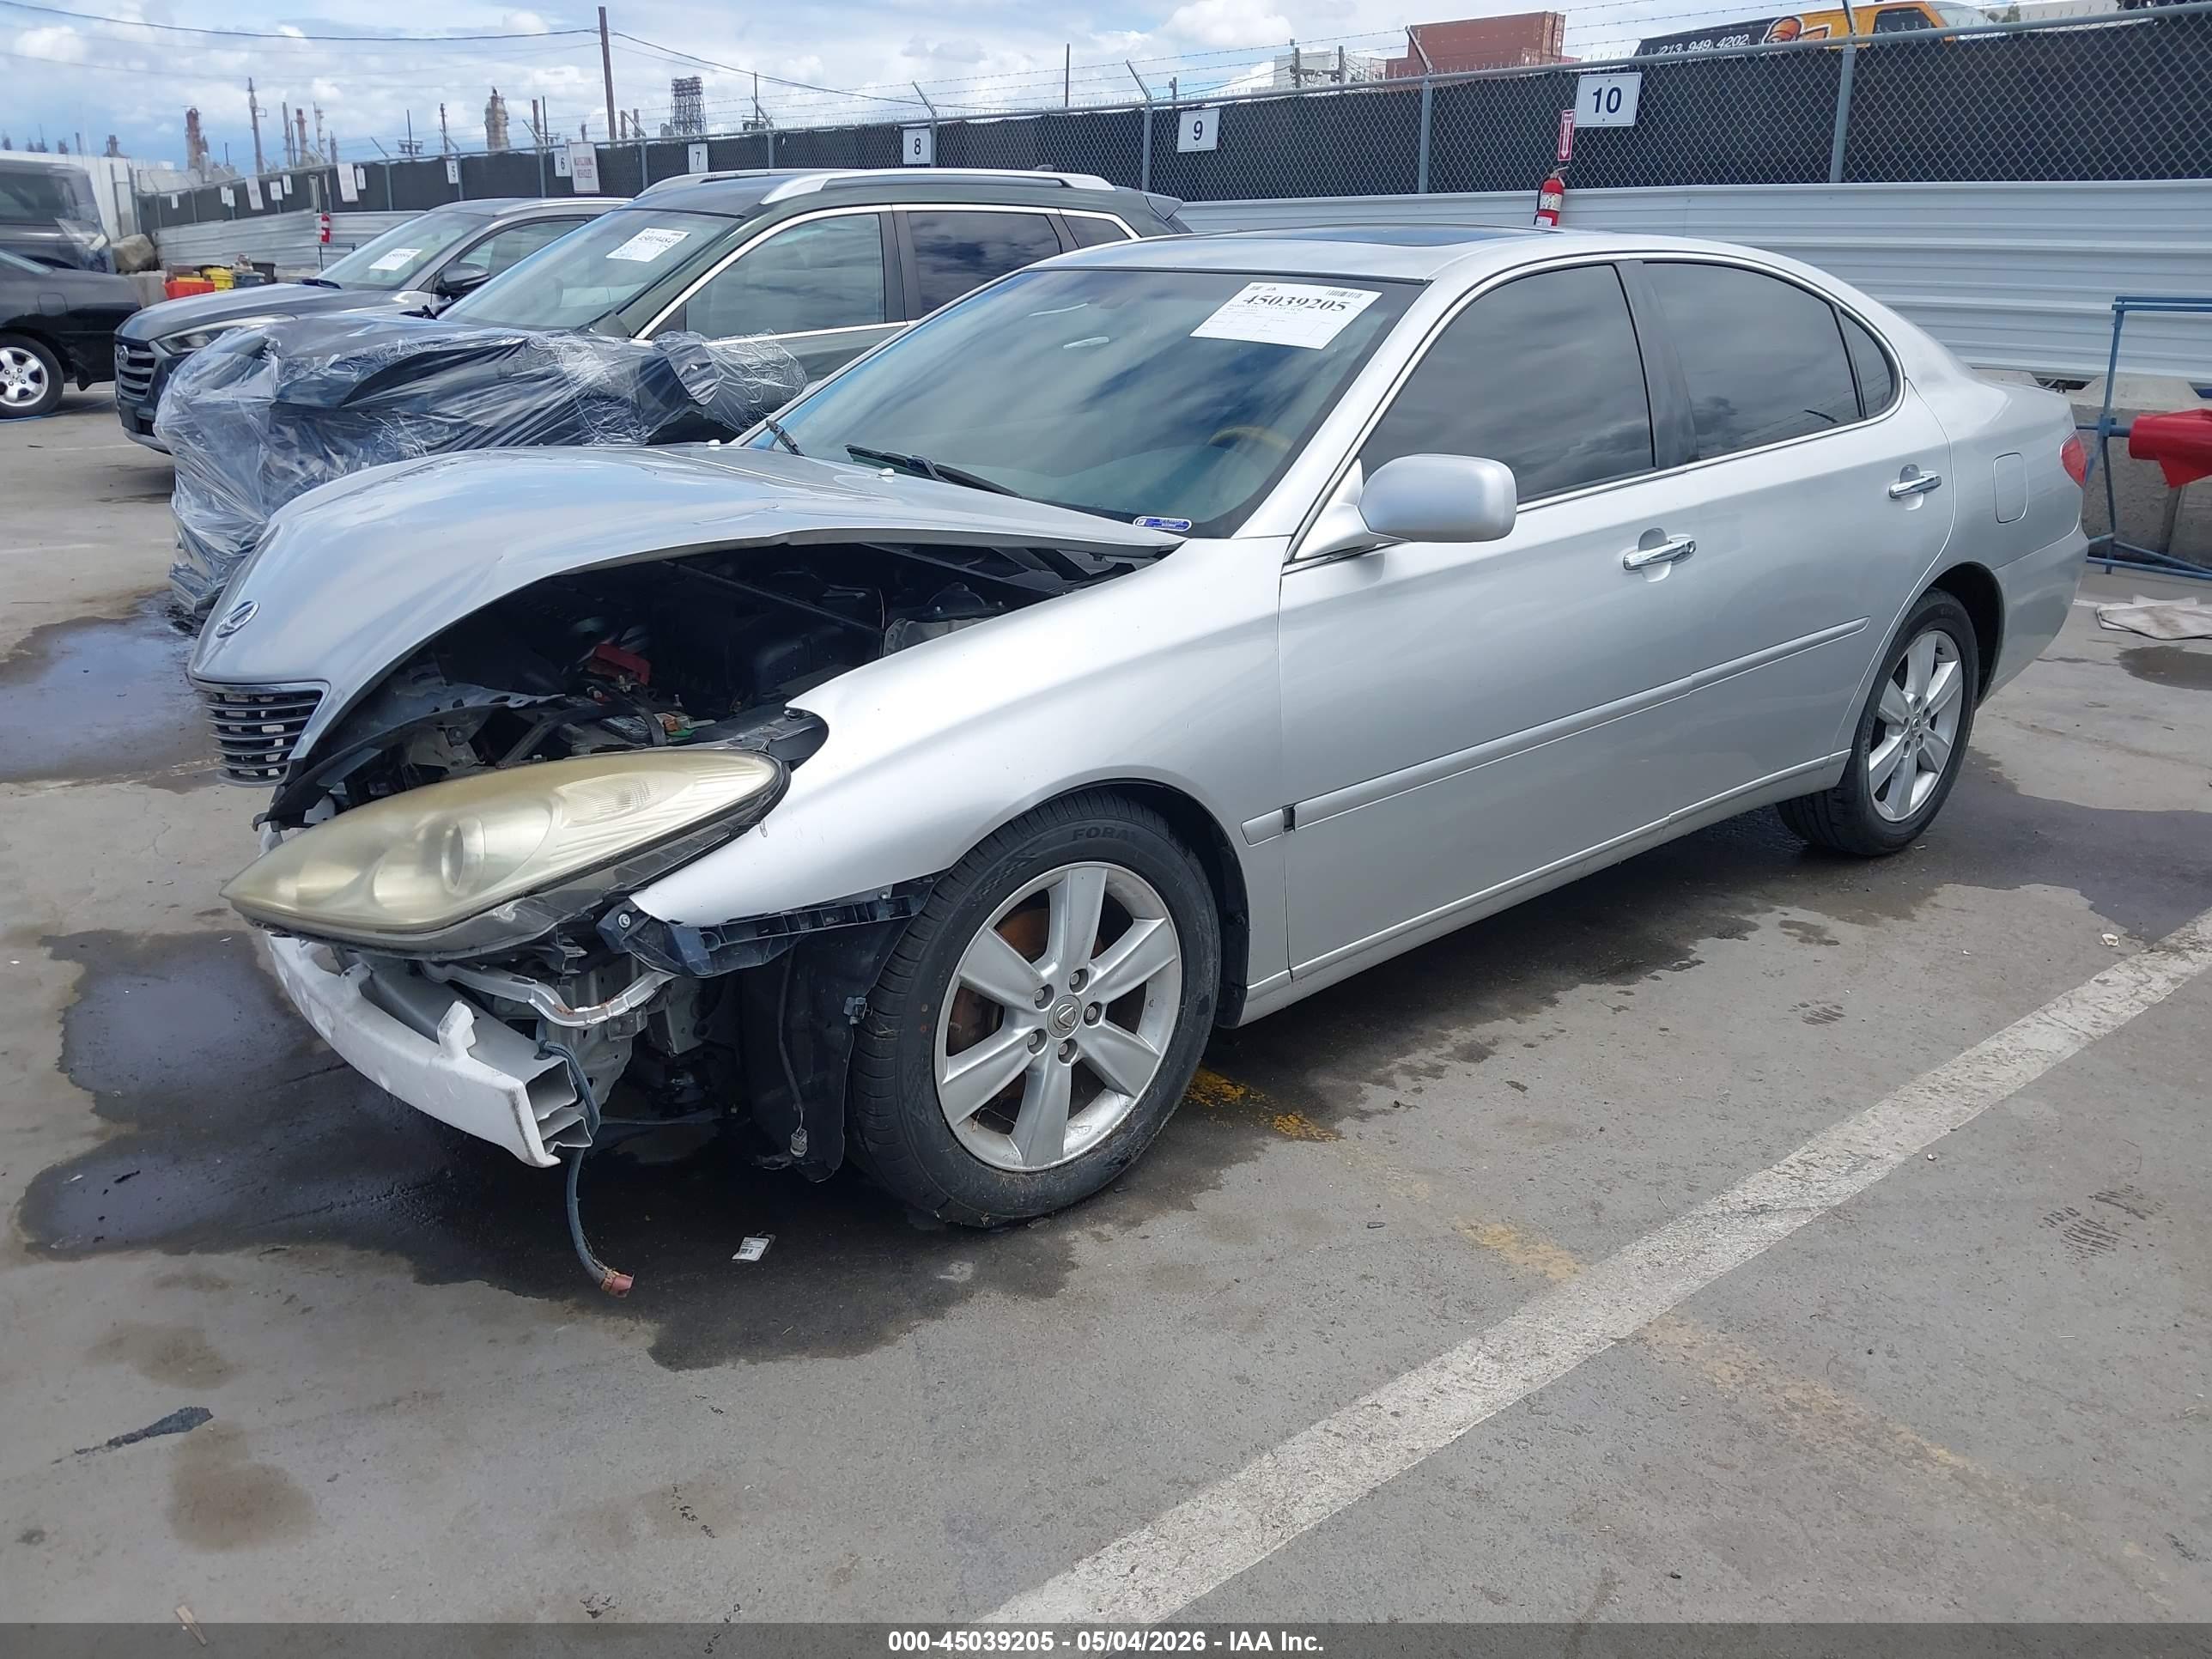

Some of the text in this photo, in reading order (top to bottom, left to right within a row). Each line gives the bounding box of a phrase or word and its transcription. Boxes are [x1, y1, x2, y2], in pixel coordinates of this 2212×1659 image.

[1658, 33, 1749, 55] 213 949 4202
[1592, 87, 1622, 113] 10
[1193, 120, 1204, 141] 9
[914, 137, 921, 155] 8
[560, 157, 566, 170] 6
[695, 151, 701, 166] 7
[1243, 295, 1351, 312] 45039205
